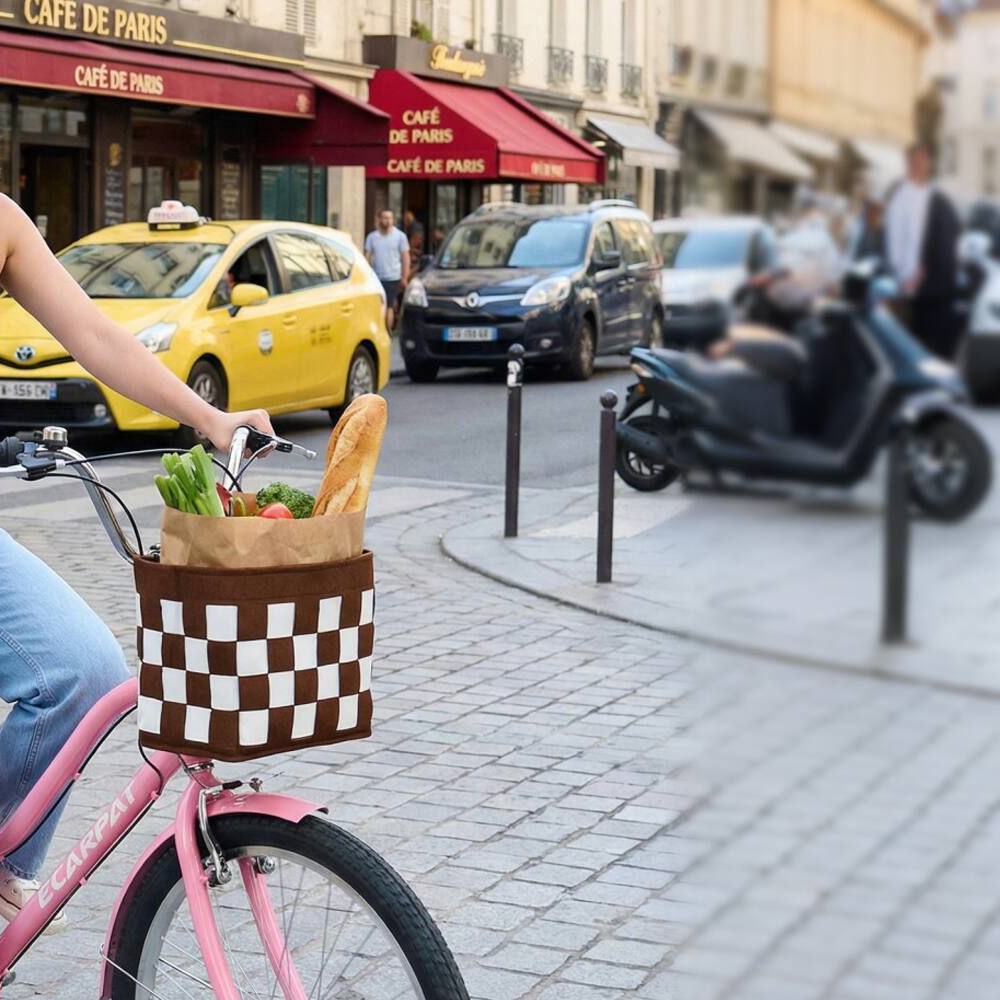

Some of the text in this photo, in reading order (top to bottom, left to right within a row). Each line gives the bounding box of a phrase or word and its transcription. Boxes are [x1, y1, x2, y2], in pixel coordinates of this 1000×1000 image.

[83, 3, 110, 36] DE
[114, 8, 168, 45] PARIS
[74, 64, 164, 95] CAFÉ DE PARIS
[402, 106, 440, 126] CAFÉ
[389, 128, 454, 144] DE PARIS
[387, 156, 486, 173] CAFÉ DE PARIS
[37, 786, 135, 909] ECARPAT
